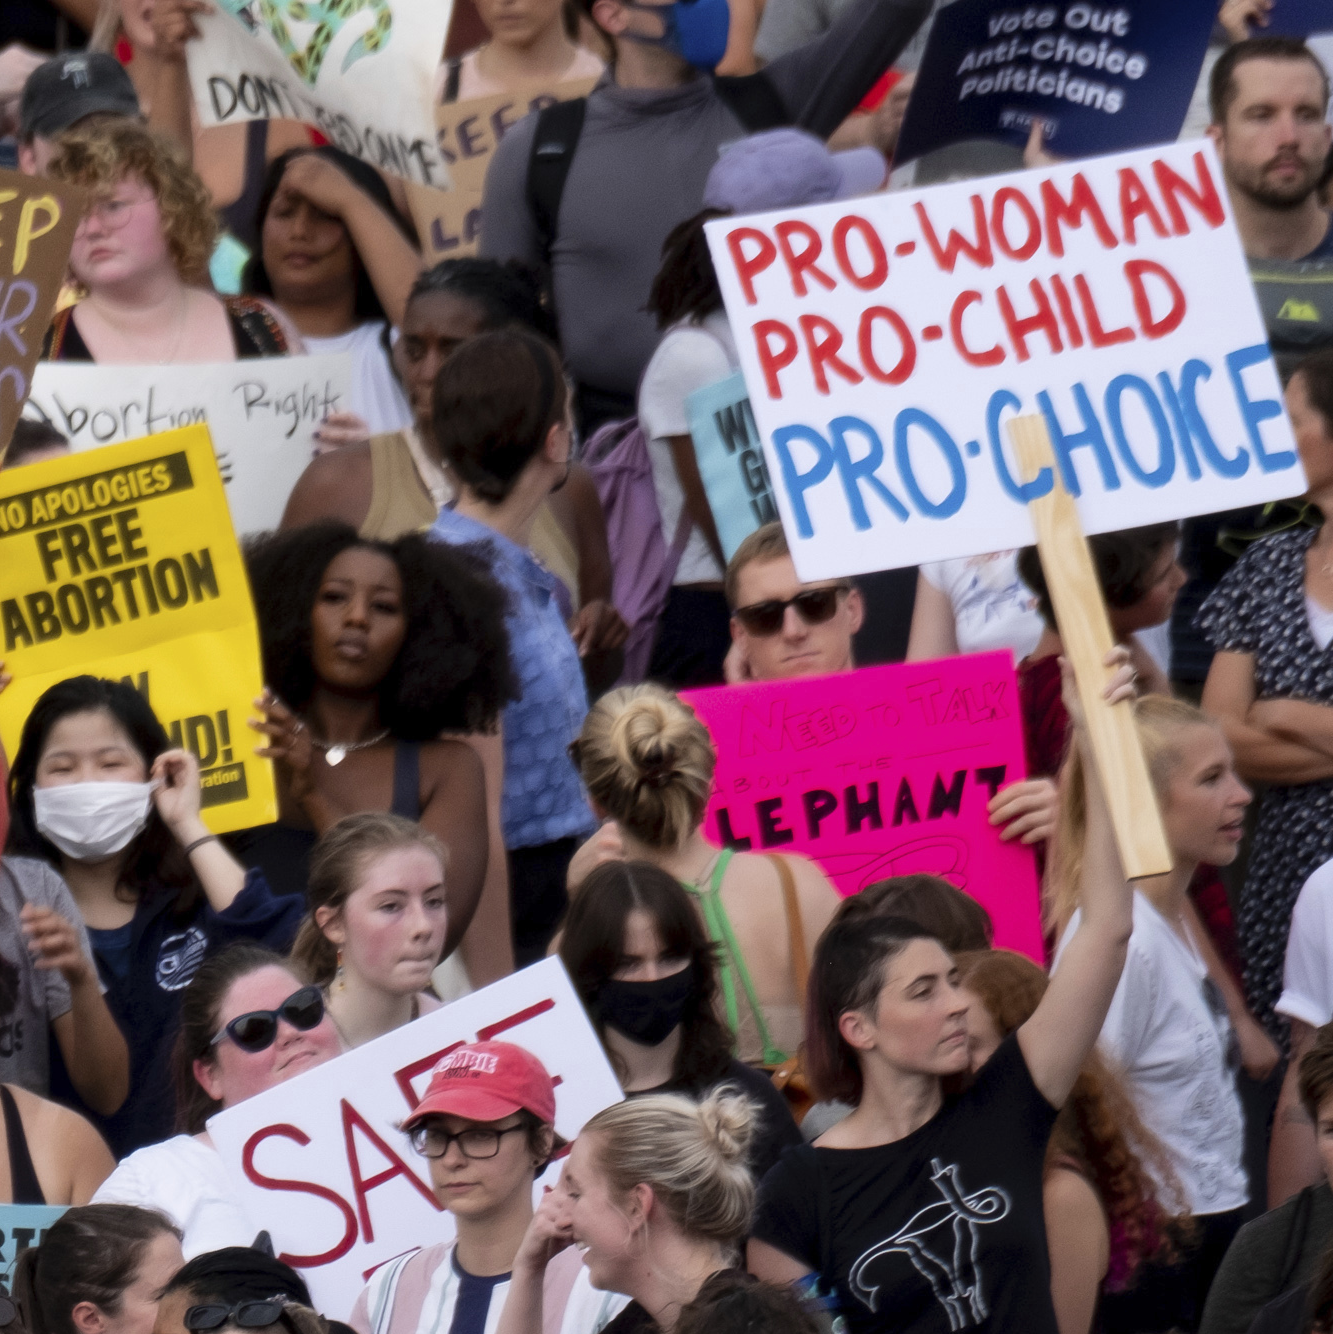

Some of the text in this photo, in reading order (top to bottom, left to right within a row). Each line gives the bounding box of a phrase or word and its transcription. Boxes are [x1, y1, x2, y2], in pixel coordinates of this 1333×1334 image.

[957, 35, 1148, 80] Anti-Choice
[989, 4, 1129, 37] Vote Out
[959, 66, 1124, 113] Politicians
[726, 150, 1226, 305] PRO-WOMAN
[751, 259, 1187, 400] PRO-CHILD
[32, 464, 173, 525] APOLOGIES
[35, 507, 149, 584] FREE
[0, 547, 221, 653] ABORTION
[714, 764, 1007, 853] LEPHANT
